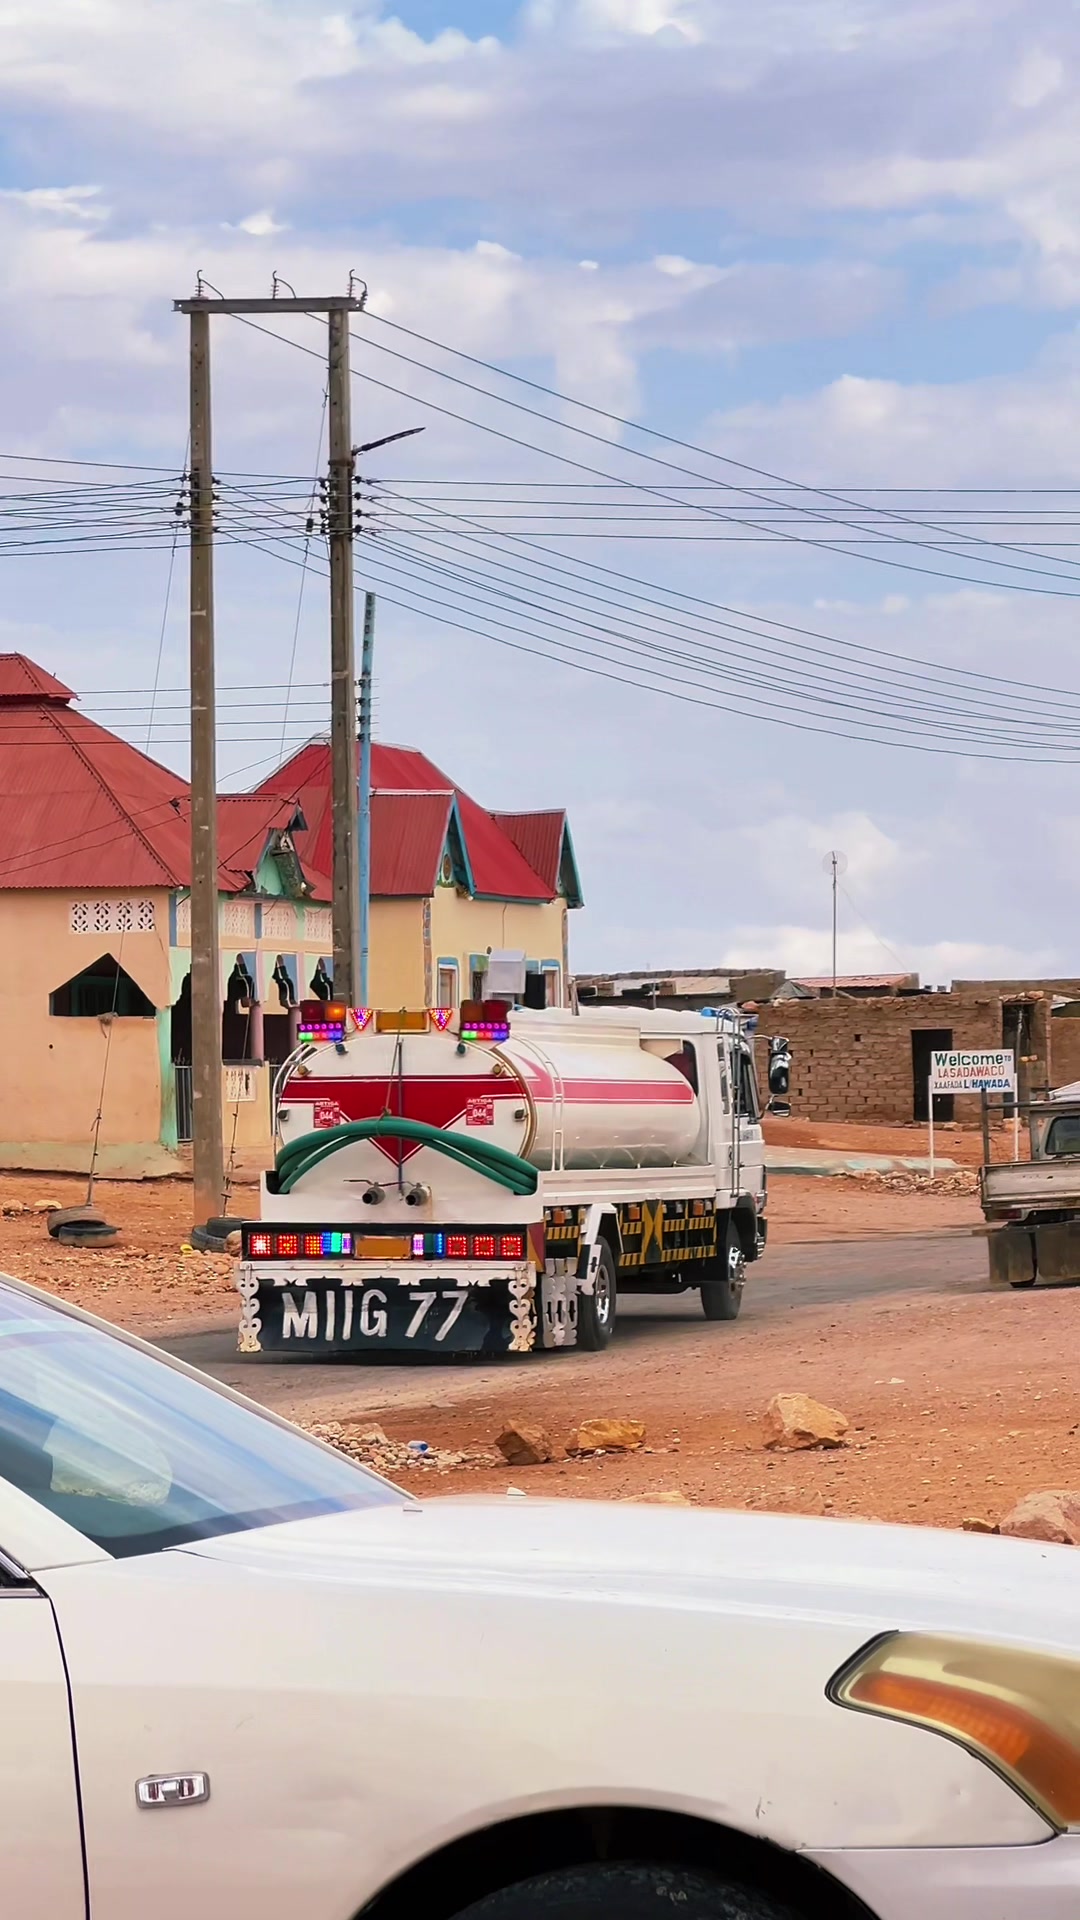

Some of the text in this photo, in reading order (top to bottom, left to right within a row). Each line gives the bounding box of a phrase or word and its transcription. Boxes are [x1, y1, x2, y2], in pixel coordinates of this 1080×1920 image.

[934, 1052, 1004, 1066] Welcome
[938, 1065, 1005, 1078] LASADAWACO
[472, 1108, 487, 1118] 044
[404, 1290, 469, 1342] 77
